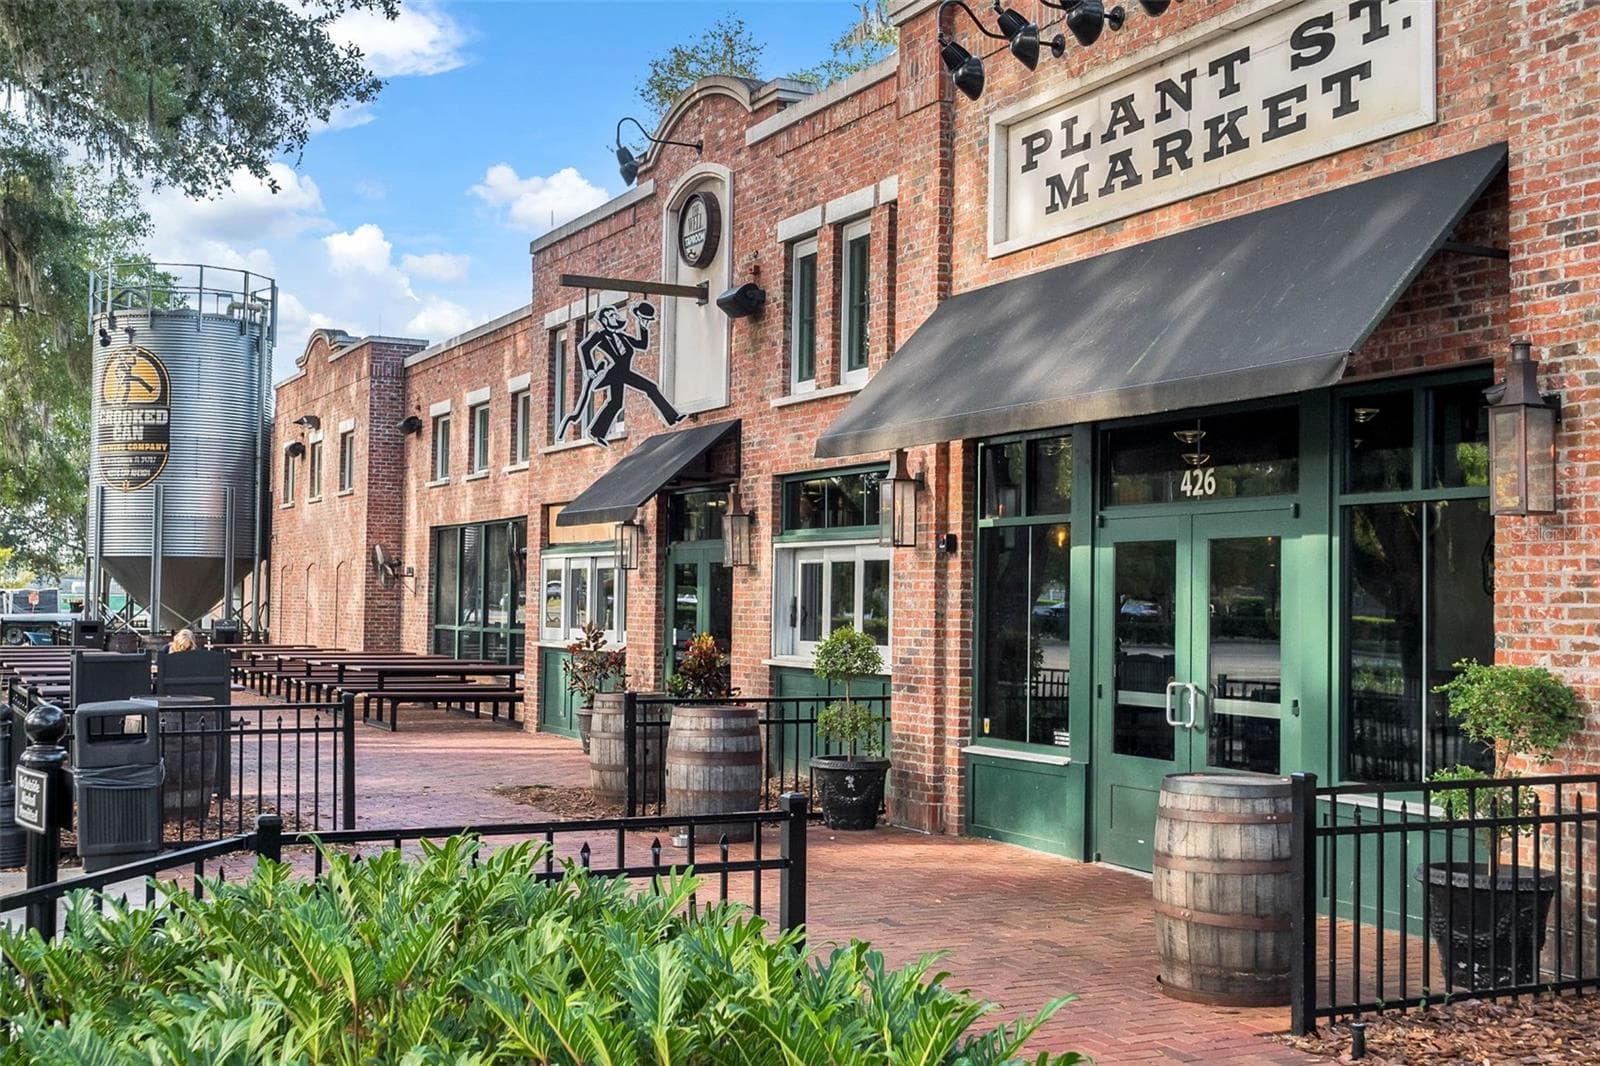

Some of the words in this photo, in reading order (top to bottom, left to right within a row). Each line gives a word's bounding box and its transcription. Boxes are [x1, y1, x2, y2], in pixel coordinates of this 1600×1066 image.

[1021, 46, 1250, 173] PLANT
[1290, 0, 1412, 71] ST.
[1045, 60, 1372, 215] MARKET
[688, 213, 702, 232] WELL
[99, 409, 168, 425] CROOKED
[112, 425, 144, 440] CAN
[127, 443, 168, 451] COMPANY
[1180, 467, 1216, 497] 426
